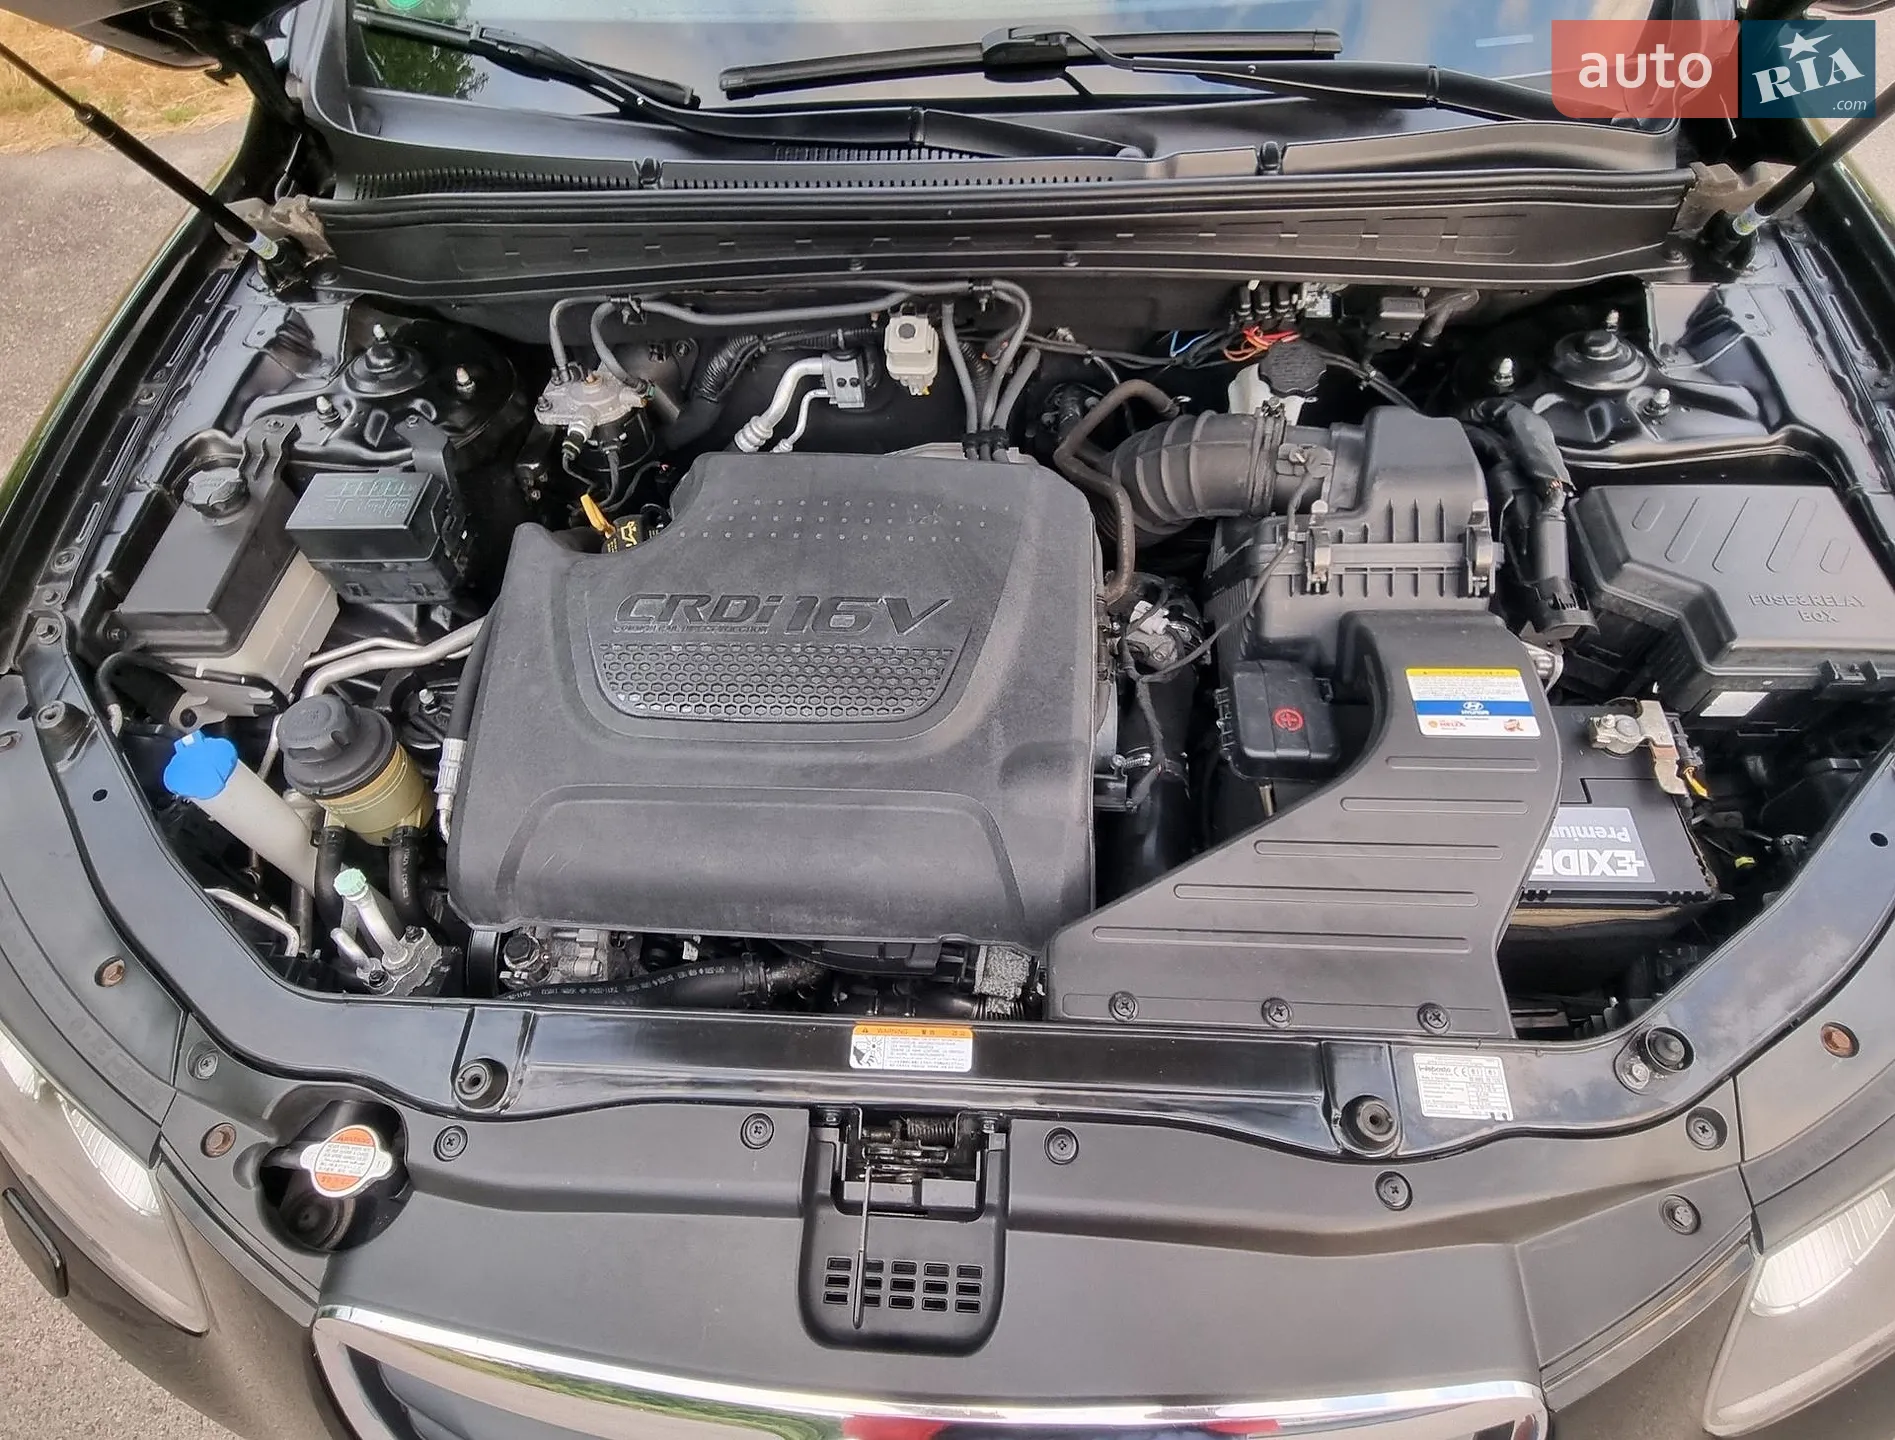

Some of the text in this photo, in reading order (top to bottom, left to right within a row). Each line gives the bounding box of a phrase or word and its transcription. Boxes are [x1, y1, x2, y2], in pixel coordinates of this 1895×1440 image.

[614, 592, 784, 626] CRDi
[1747, 594, 1866, 608] FUSE&RELAY
[1797, 610, 1840, 623] BOX
[1531, 848, 1645, 877] EXIDE
